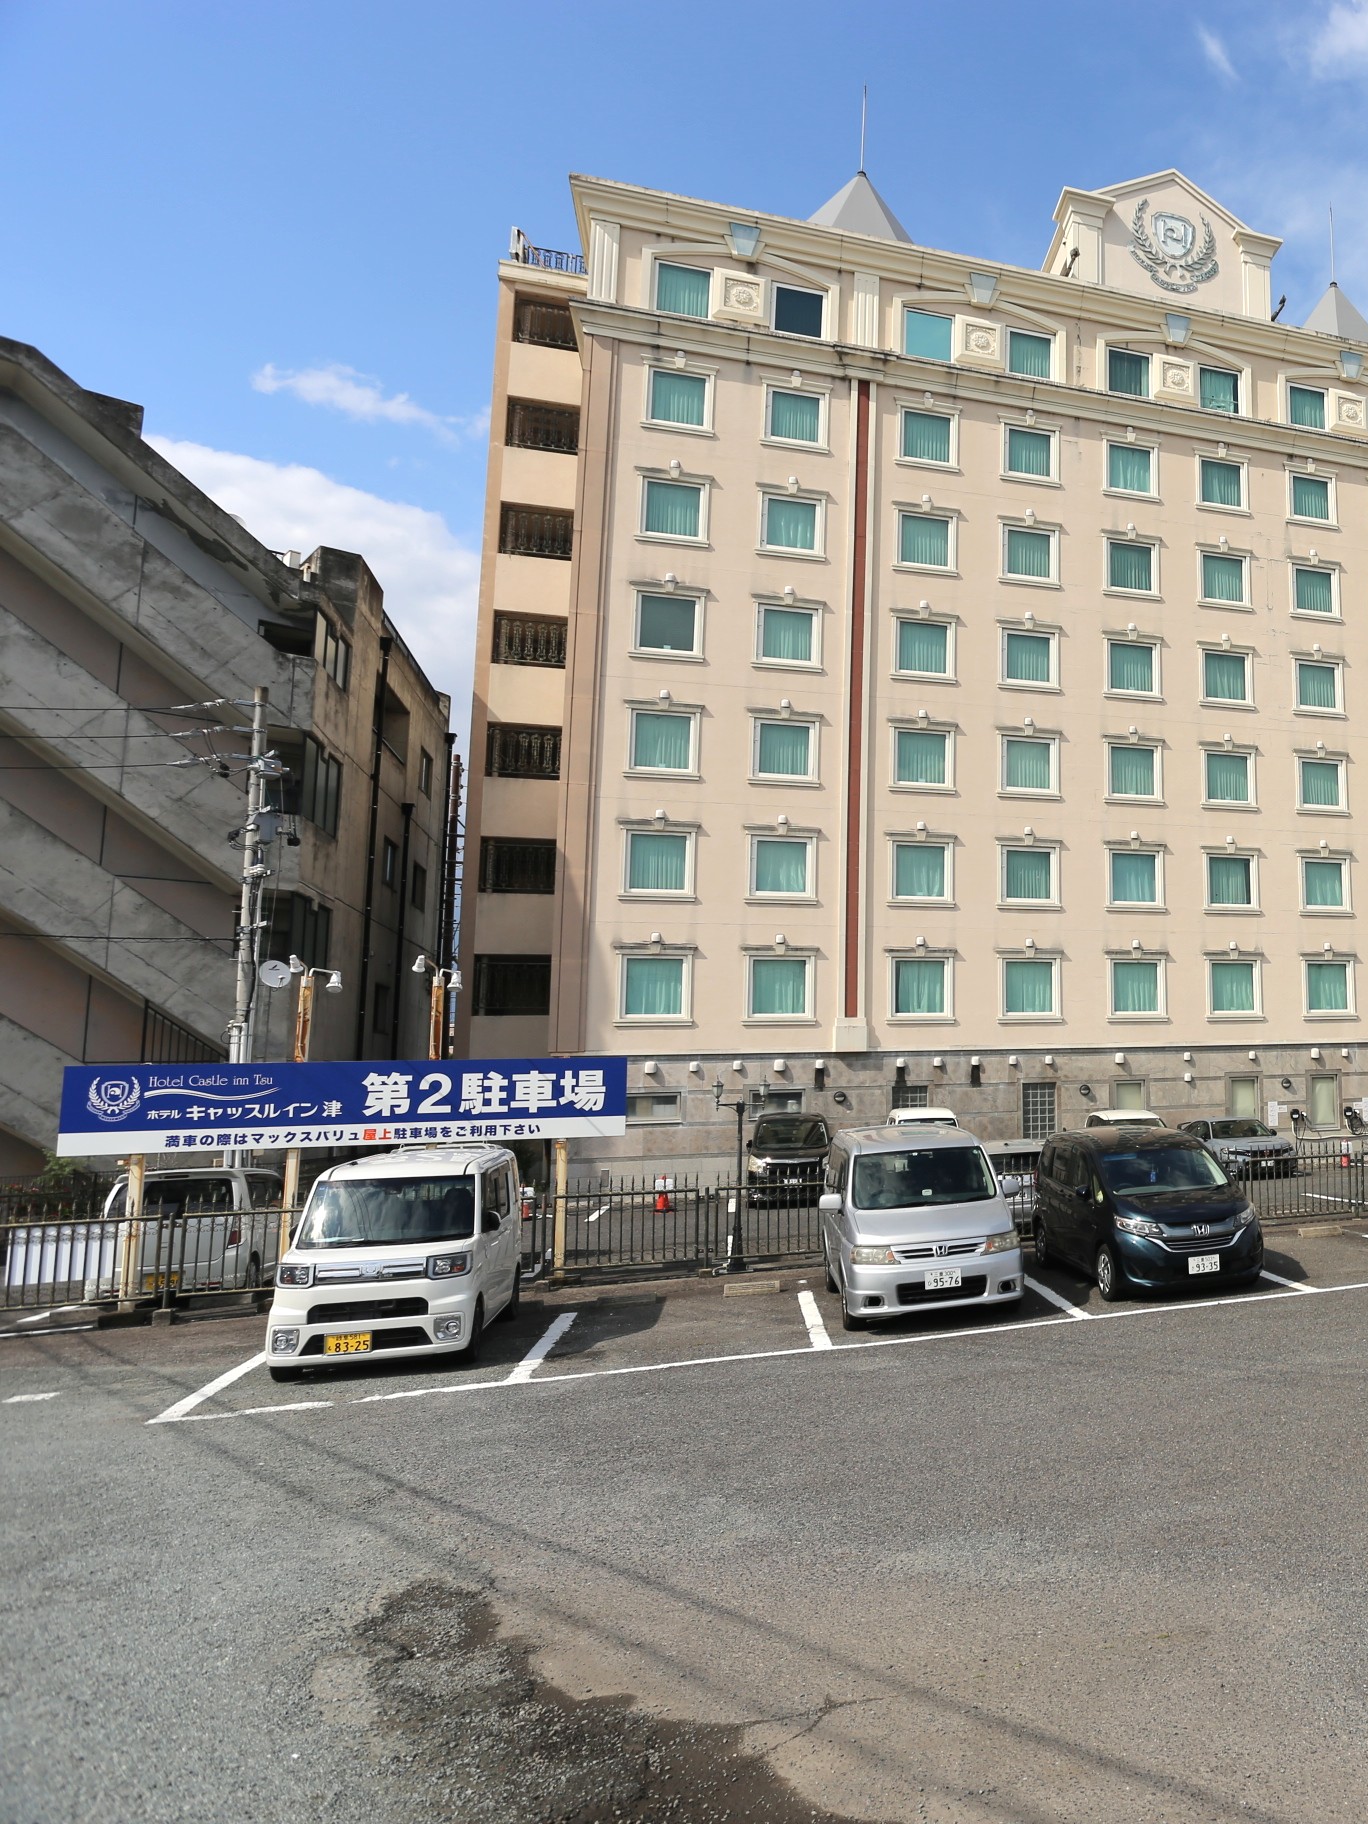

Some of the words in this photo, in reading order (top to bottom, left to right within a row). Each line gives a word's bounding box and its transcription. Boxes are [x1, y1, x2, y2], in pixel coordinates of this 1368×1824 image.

[148, 1075, 184, 1088] Hotel
[188, 1074, 229, 1087] Castle
[233, 1074, 249, 1086] inn
[253, 1073, 274, 1086] Tsu
[361, 1069, 607, 1117] 第2駐車場
[146, 1109, 183, 1120] ホテル
[185, 1102, 319, 1121] キャッスルイン
[321, 1100, 343, 1118] 津
[164, 1123, 542, 1149] 満車の際はマックスバリュ屋上駐車場をご利用下さい
[1195, 1260, 1219, 1273] 93-35
[933, 1275, 960, 1288] 95-76
[334, 1339, 370, 1353] 83-25
